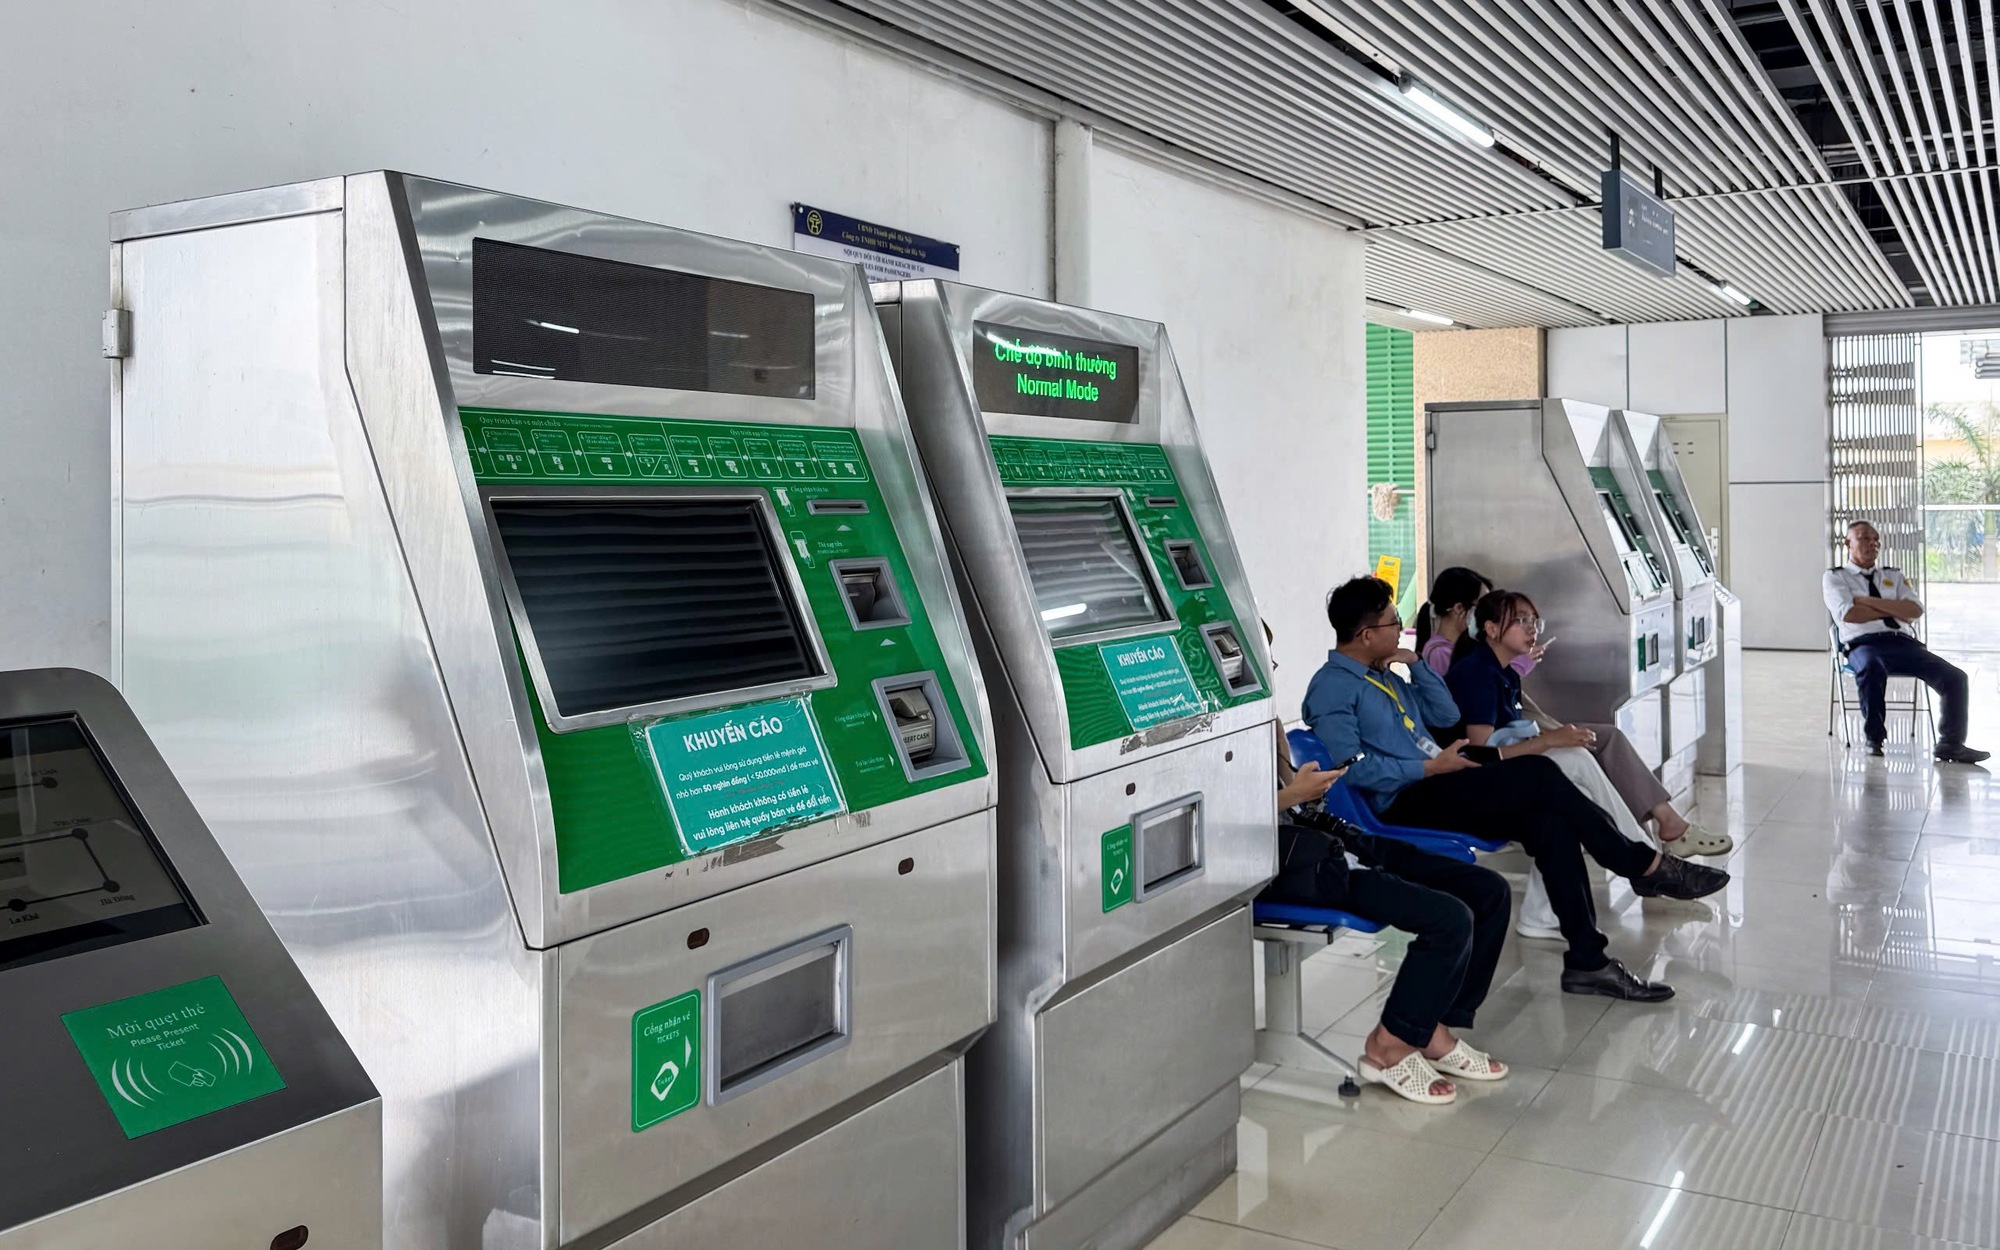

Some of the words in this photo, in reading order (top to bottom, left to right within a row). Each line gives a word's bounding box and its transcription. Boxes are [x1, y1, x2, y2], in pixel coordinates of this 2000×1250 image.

[1075, 352, 1117, 380] thường
[1017, 373, 1063, 398] Normal
[1065, 378, 1099, 402] Mode
[1116, 647, 1149, 667] KHUYẾN
[1147, 645, 1166, 661] CÁO
[682, 720, 748, 752] KHUYẾN
[748, 715, 783, 738] CÁO
[903, 735, 917, 743] SERT
[916, 731, 930, 741] CASH
[678, 772, 693, 782] Quý
[693, 767, 714, 778] khách
[713, 765, 724, 774] vui
[724, 762, 738, 772] lòng
[746, 756, 763, 766] dụng
[762, 753, 774, 762] tiền
[780, 748, 797, 758] mệnh
[703, 784, 713, 793] 50
[731, 775, 748, 786] đồng
[755, 767, 787, 779] 50.000vnđ
[798, 760, 811, 768] mua
[811, 757, 819, 767] vé
[692, 830, 707, 840] vui
[706, 826, 726, 838] lòng
[725, 820, 740, 832] liên
[740, 816, 751, 828] hệ
[770, 807, 786, 819] bán
[786, 803, 796, 814] vé
[806, 794, 818, 808] đổi
[817, 794, 832, 806] tiền
[707, 807, 730, 819] Hành
[730, 800, 754, 814] khách
[753, 795, 777, 808] không
[777, 791, 786, 800] có
[786, 787, 801, 798] tiền
[9, 917, 21, 925] La
[106, 1020, 143, 1039] Mời
[144, 1012, 179, 1031] quẹt
[181, 1003, 206, 1019] thẻ
[664, 1016, 681, 1029] nhận
[682, 1010, 691, 1021] vé
[130, 1034, 161, 1047] Please
[163, 1023, 200, 1038] Present
[156, 1038, 187, 1051] Ticket
[657, 1029, 680, 1044] TICKETS
